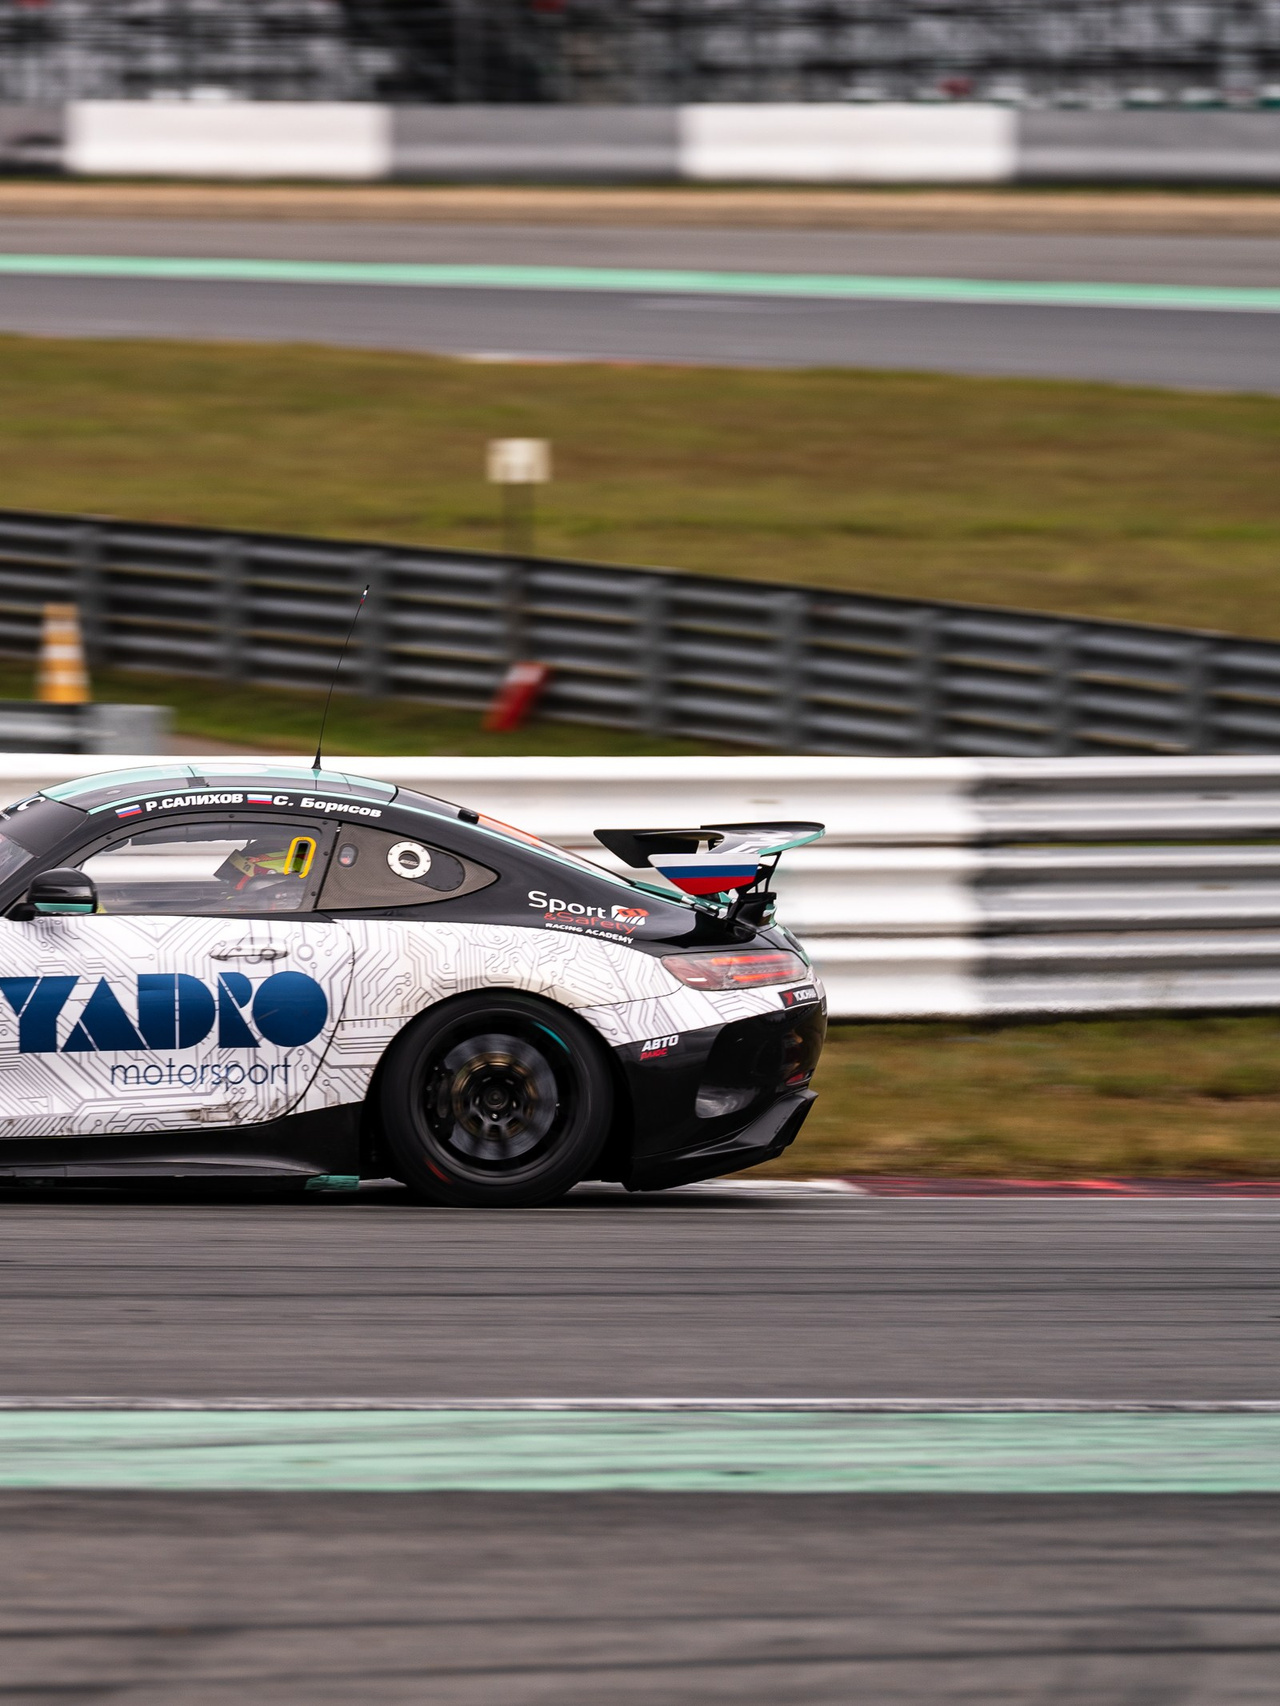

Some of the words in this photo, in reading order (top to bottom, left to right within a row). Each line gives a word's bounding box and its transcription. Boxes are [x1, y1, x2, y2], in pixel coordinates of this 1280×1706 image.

[145, 793, 244, 812] Р.САЛИХОВ
[300, 797, 382, 818] Борисов
[527, 890, 607, 919] Sport
[543, 911, 637, 935] &Safety
[545, 922, 583, 933] RACING
[584, 928, 634, 944] ACADEMY
[110, 1057, 292, 1091] motorsport
